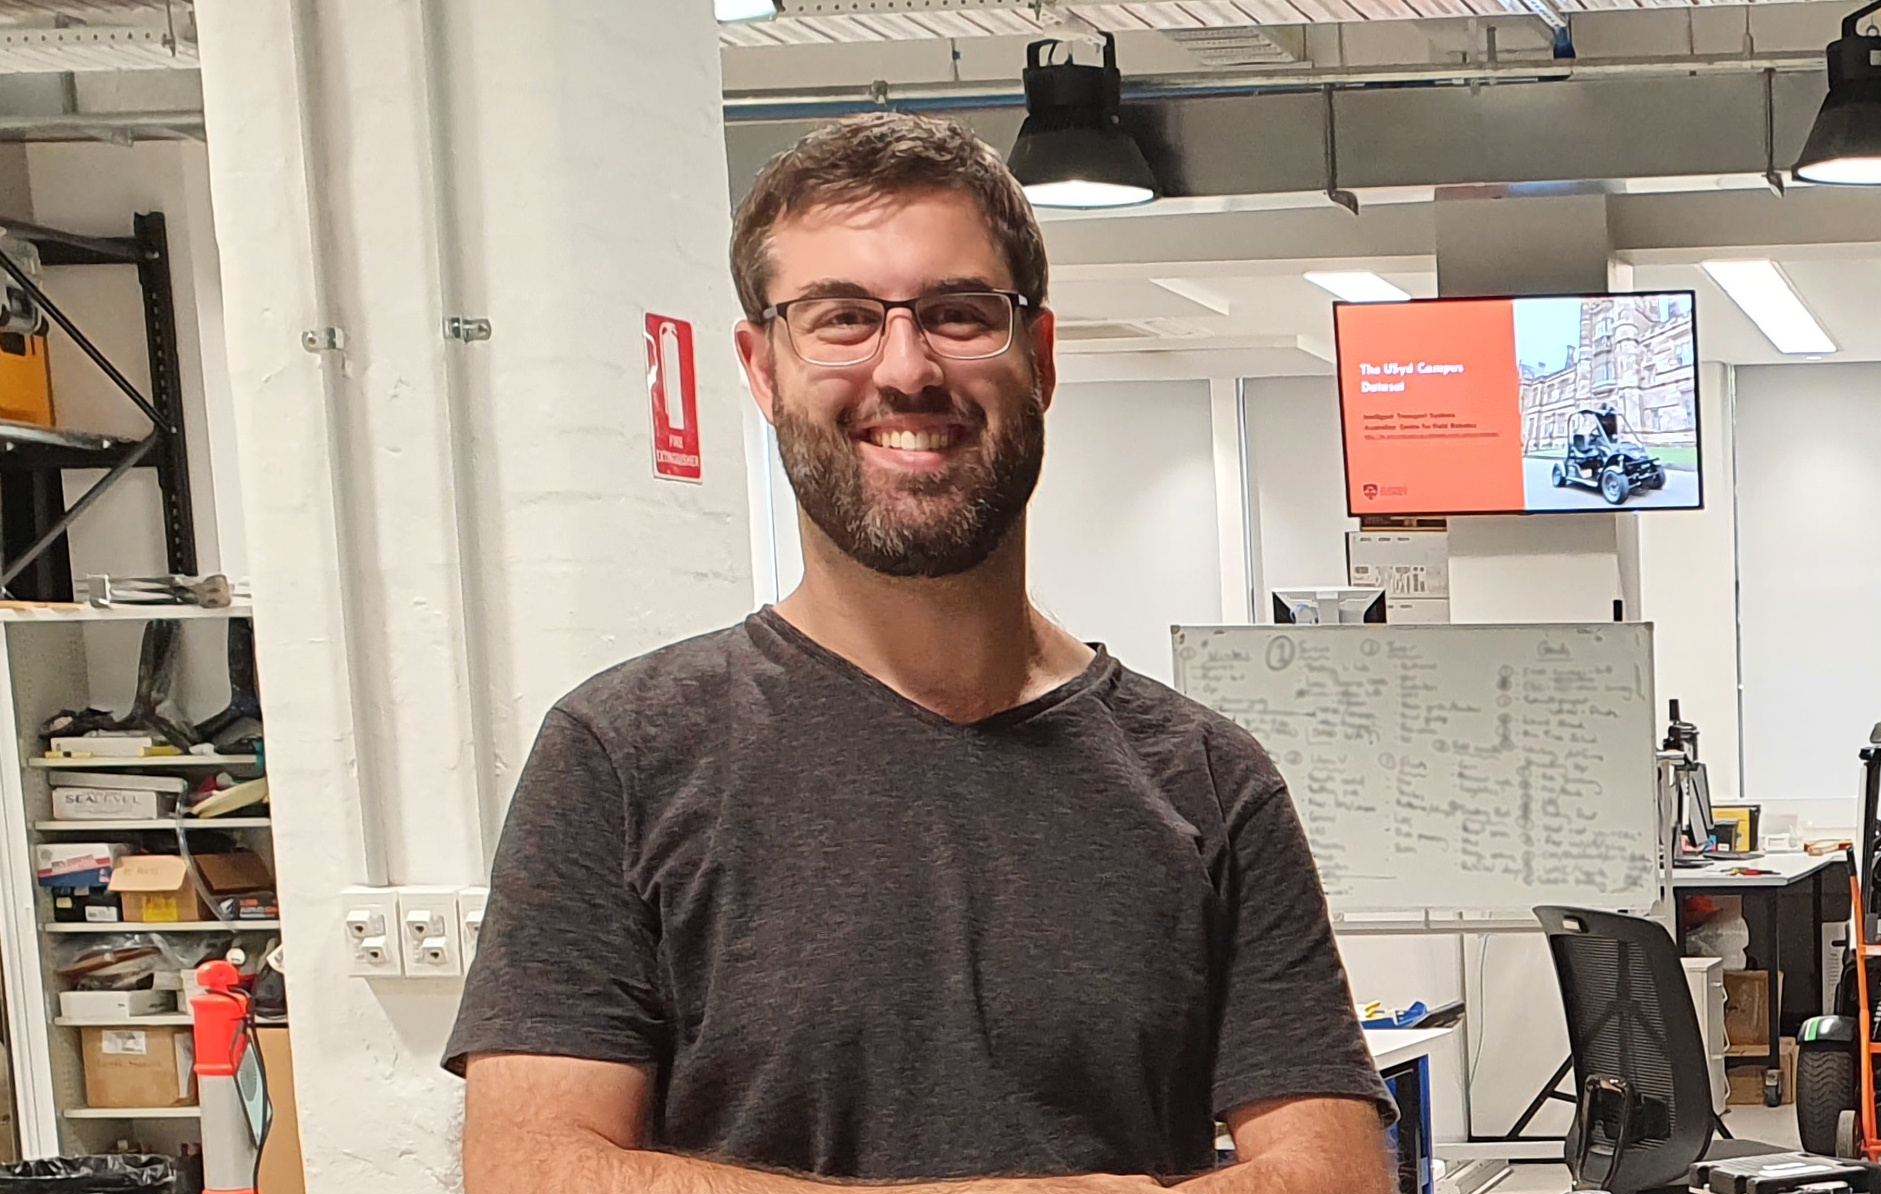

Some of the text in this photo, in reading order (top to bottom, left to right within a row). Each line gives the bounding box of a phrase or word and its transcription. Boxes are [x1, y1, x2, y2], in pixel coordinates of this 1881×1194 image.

[1359, 362, 1464, 376] The USyd Campus
[1361, 381, 1405, 393] Dataset
